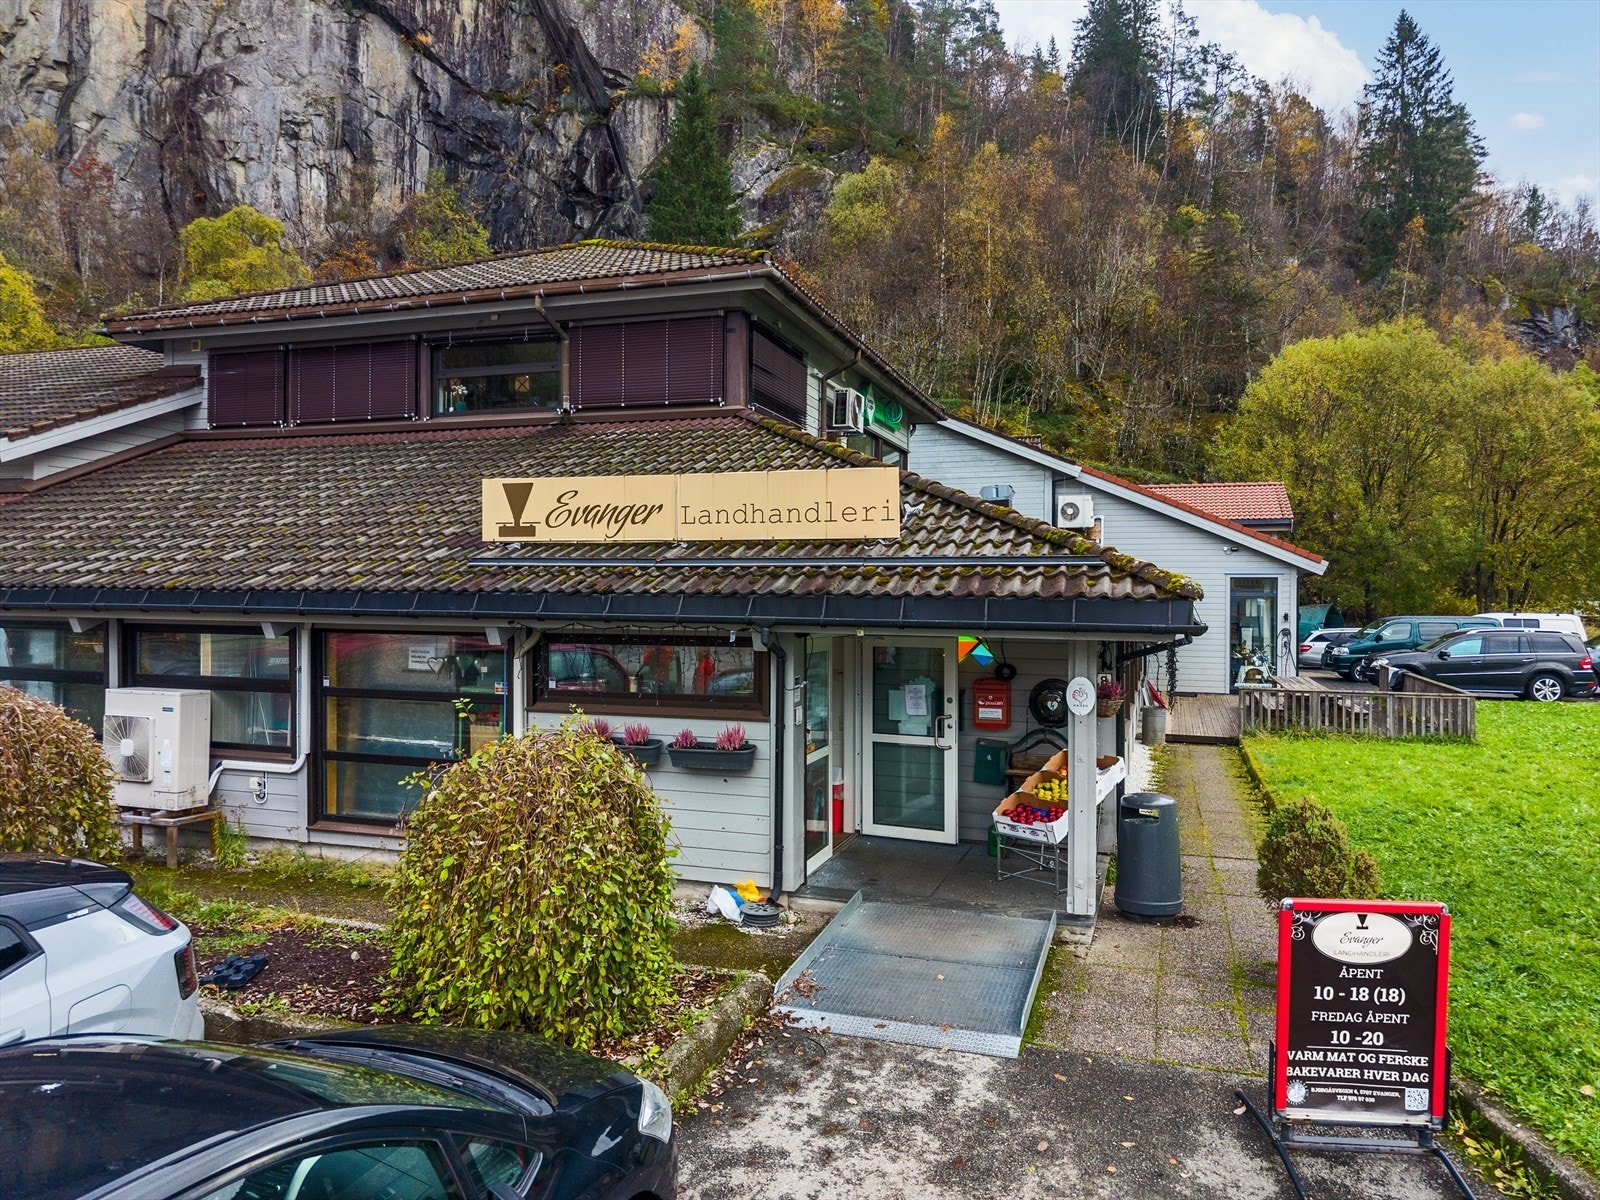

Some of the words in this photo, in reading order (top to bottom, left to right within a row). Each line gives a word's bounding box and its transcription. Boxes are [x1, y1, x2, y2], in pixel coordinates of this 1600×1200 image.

[545, 490, 664, 539] Evanger
[680, 499, 896, 525] Landhandleri
[1339, 931, 1384, 948] Evanger
[1333, 949, 1391, 957] LANDHANDLERI
[1338, 965, 1384, 979] ÅPENT
[1313, 985, 1334, 1001] 10
[1349, 987, 1370, 1001] 18
[1373, 986, 1406, 1006] (18)
[1311, 1010, 1363, 1022] FREDAG
[1365, 1010, 1410, 1024] ÅPENT
[1330, 1030, 1351, 1044] 10
[1287, 1050, 1325, 1061] VARM
[1326, 1051, 1356, 1062] MAT
[1358, 1053, 1377, 1064] OG
[1378, 1054, 1429, 1067] FERSKE
[1286, 1066, 1361, 1079] BAKEVARER
[1363, 1069, 1400, 1081] HVER
[1402, 1072, 1429, 1083] DAG
